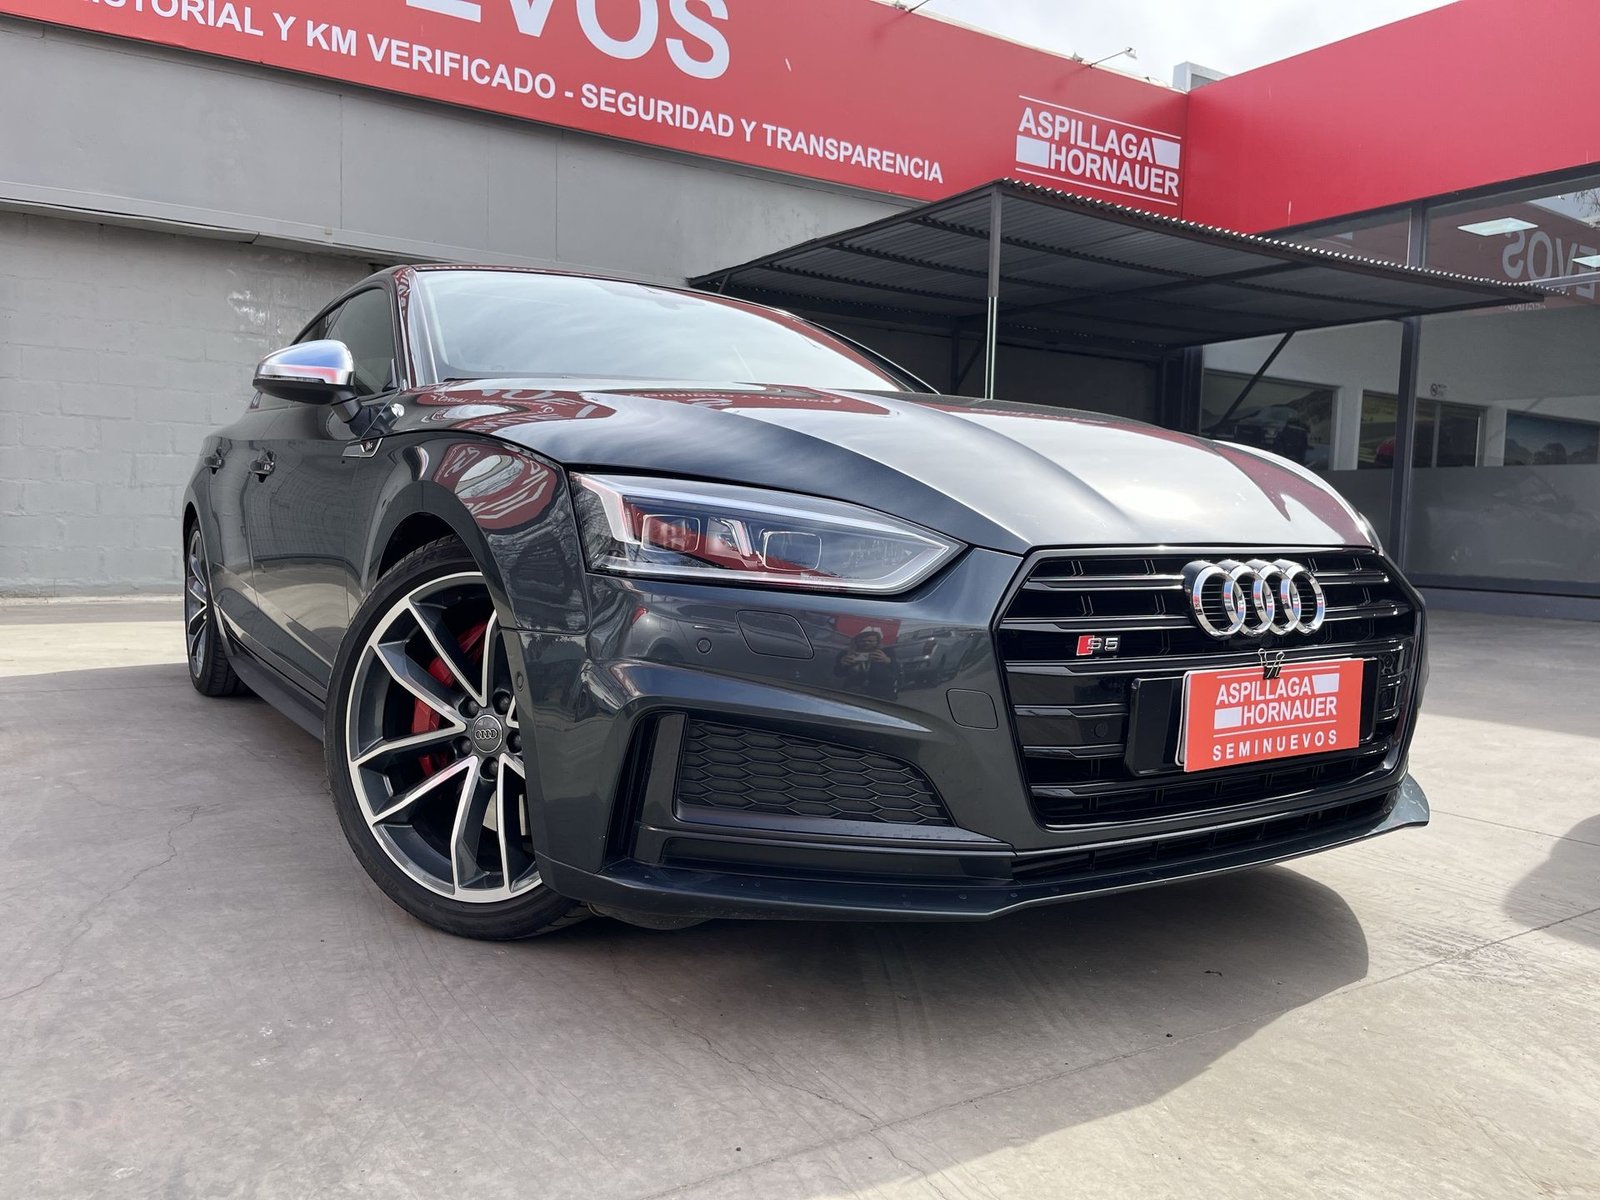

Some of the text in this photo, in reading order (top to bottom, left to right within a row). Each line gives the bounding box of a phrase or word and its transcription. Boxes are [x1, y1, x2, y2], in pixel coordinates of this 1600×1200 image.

[272, 12, 297, 42] Y
[306, 20, 357, 57] KM
[366, 33, 556, 99] VERIFICADO
[581, 83, 734, 138] SEGURIDAD
[740, 118, 757, 143] Y
[762, 123, 943, 184] TRANSPARENCIA
[1018, 107, 1154, 164] ASPILLAGA
[1050, 144, 1179, 197] HORNAUER
[1216, 676, 1312, 706] ASPILLAGA
[1243, 696, 1337, 726] HORNAUER
[1212, 729, 1337, 761] SEMINUEVOS
